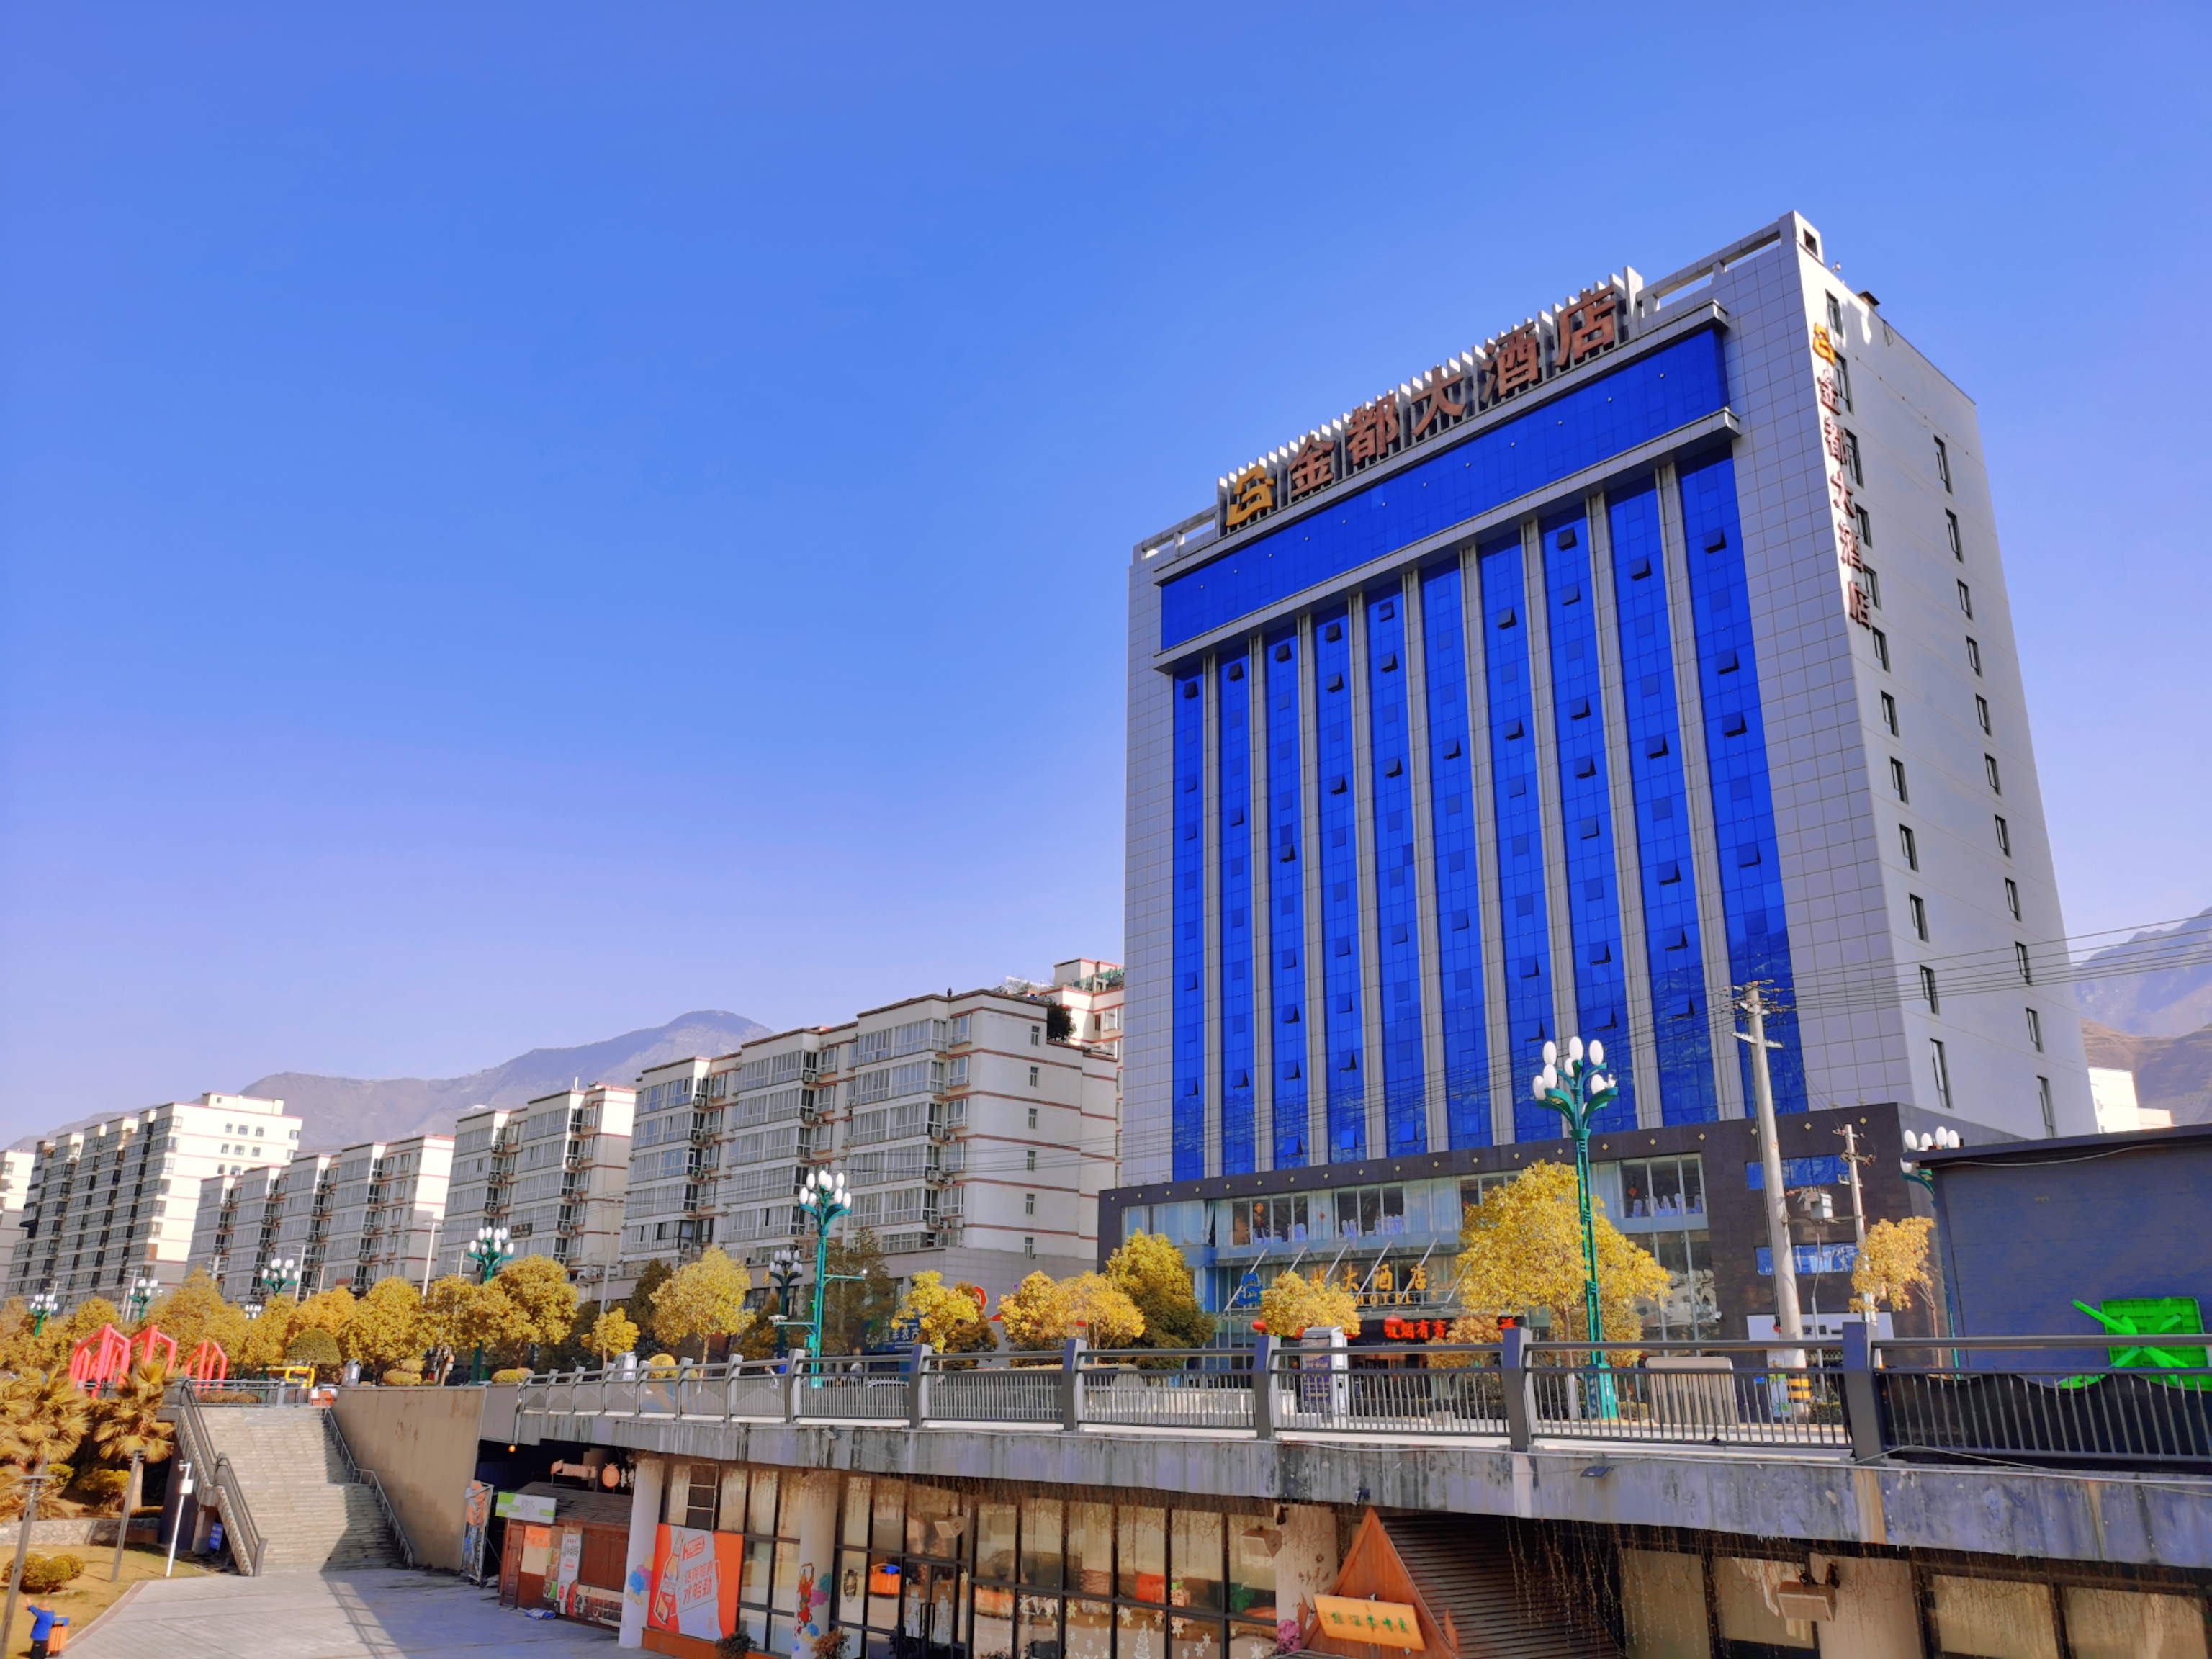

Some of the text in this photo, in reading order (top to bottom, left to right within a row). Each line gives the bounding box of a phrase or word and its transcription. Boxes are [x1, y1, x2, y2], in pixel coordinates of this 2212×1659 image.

[1287, 285, 1616, 497] 金都大酒店
[1816, 369, 1873, 630] 金都大酒店
[1357, 1292, 1413, 1305] HOTEL
